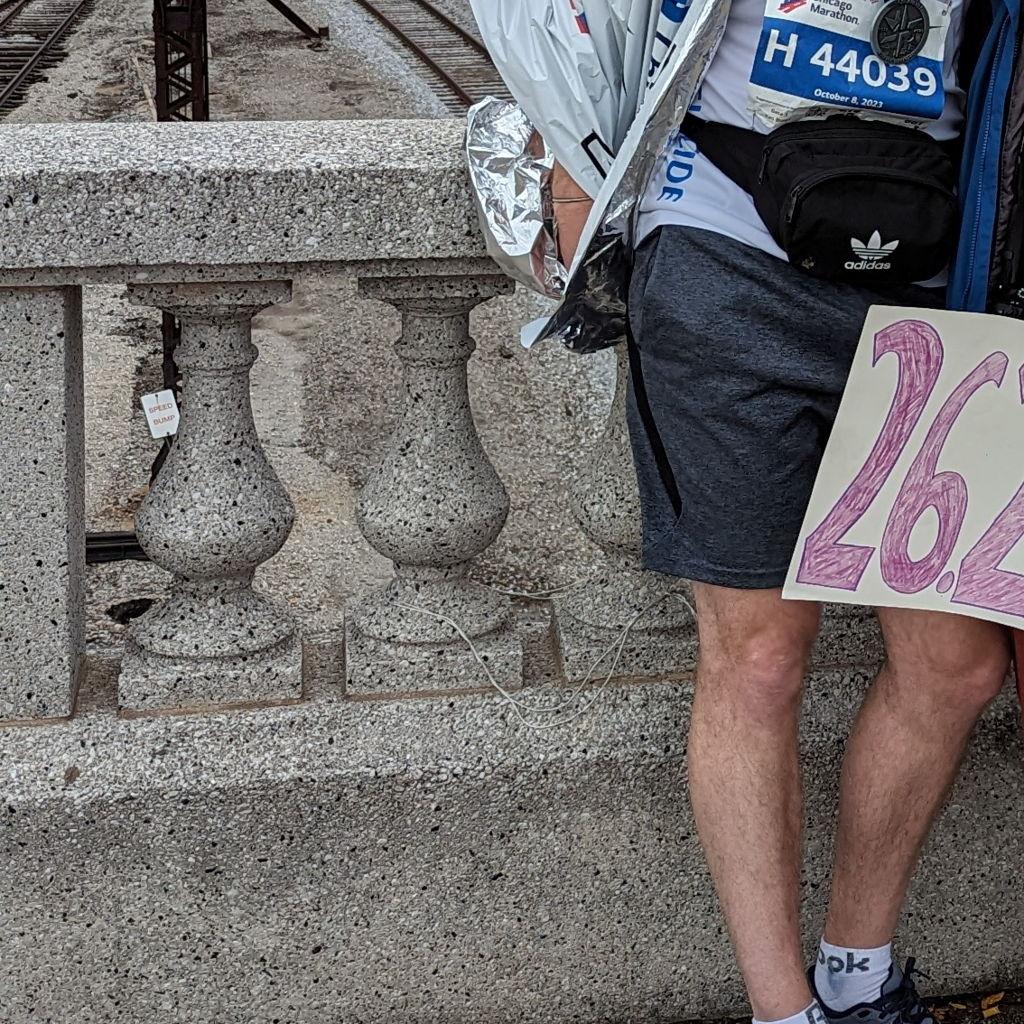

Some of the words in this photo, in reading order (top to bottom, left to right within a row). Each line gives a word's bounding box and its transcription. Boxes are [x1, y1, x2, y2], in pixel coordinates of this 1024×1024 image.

[764, 29, 798, 68] H
[810, 43, 937, 97] 44039
[814, 88, 850, 103] October
[850, 95, 859, 106] 8,
[861, 97, 884, 108] 2023
[844, 261, 891, 270] adidas
